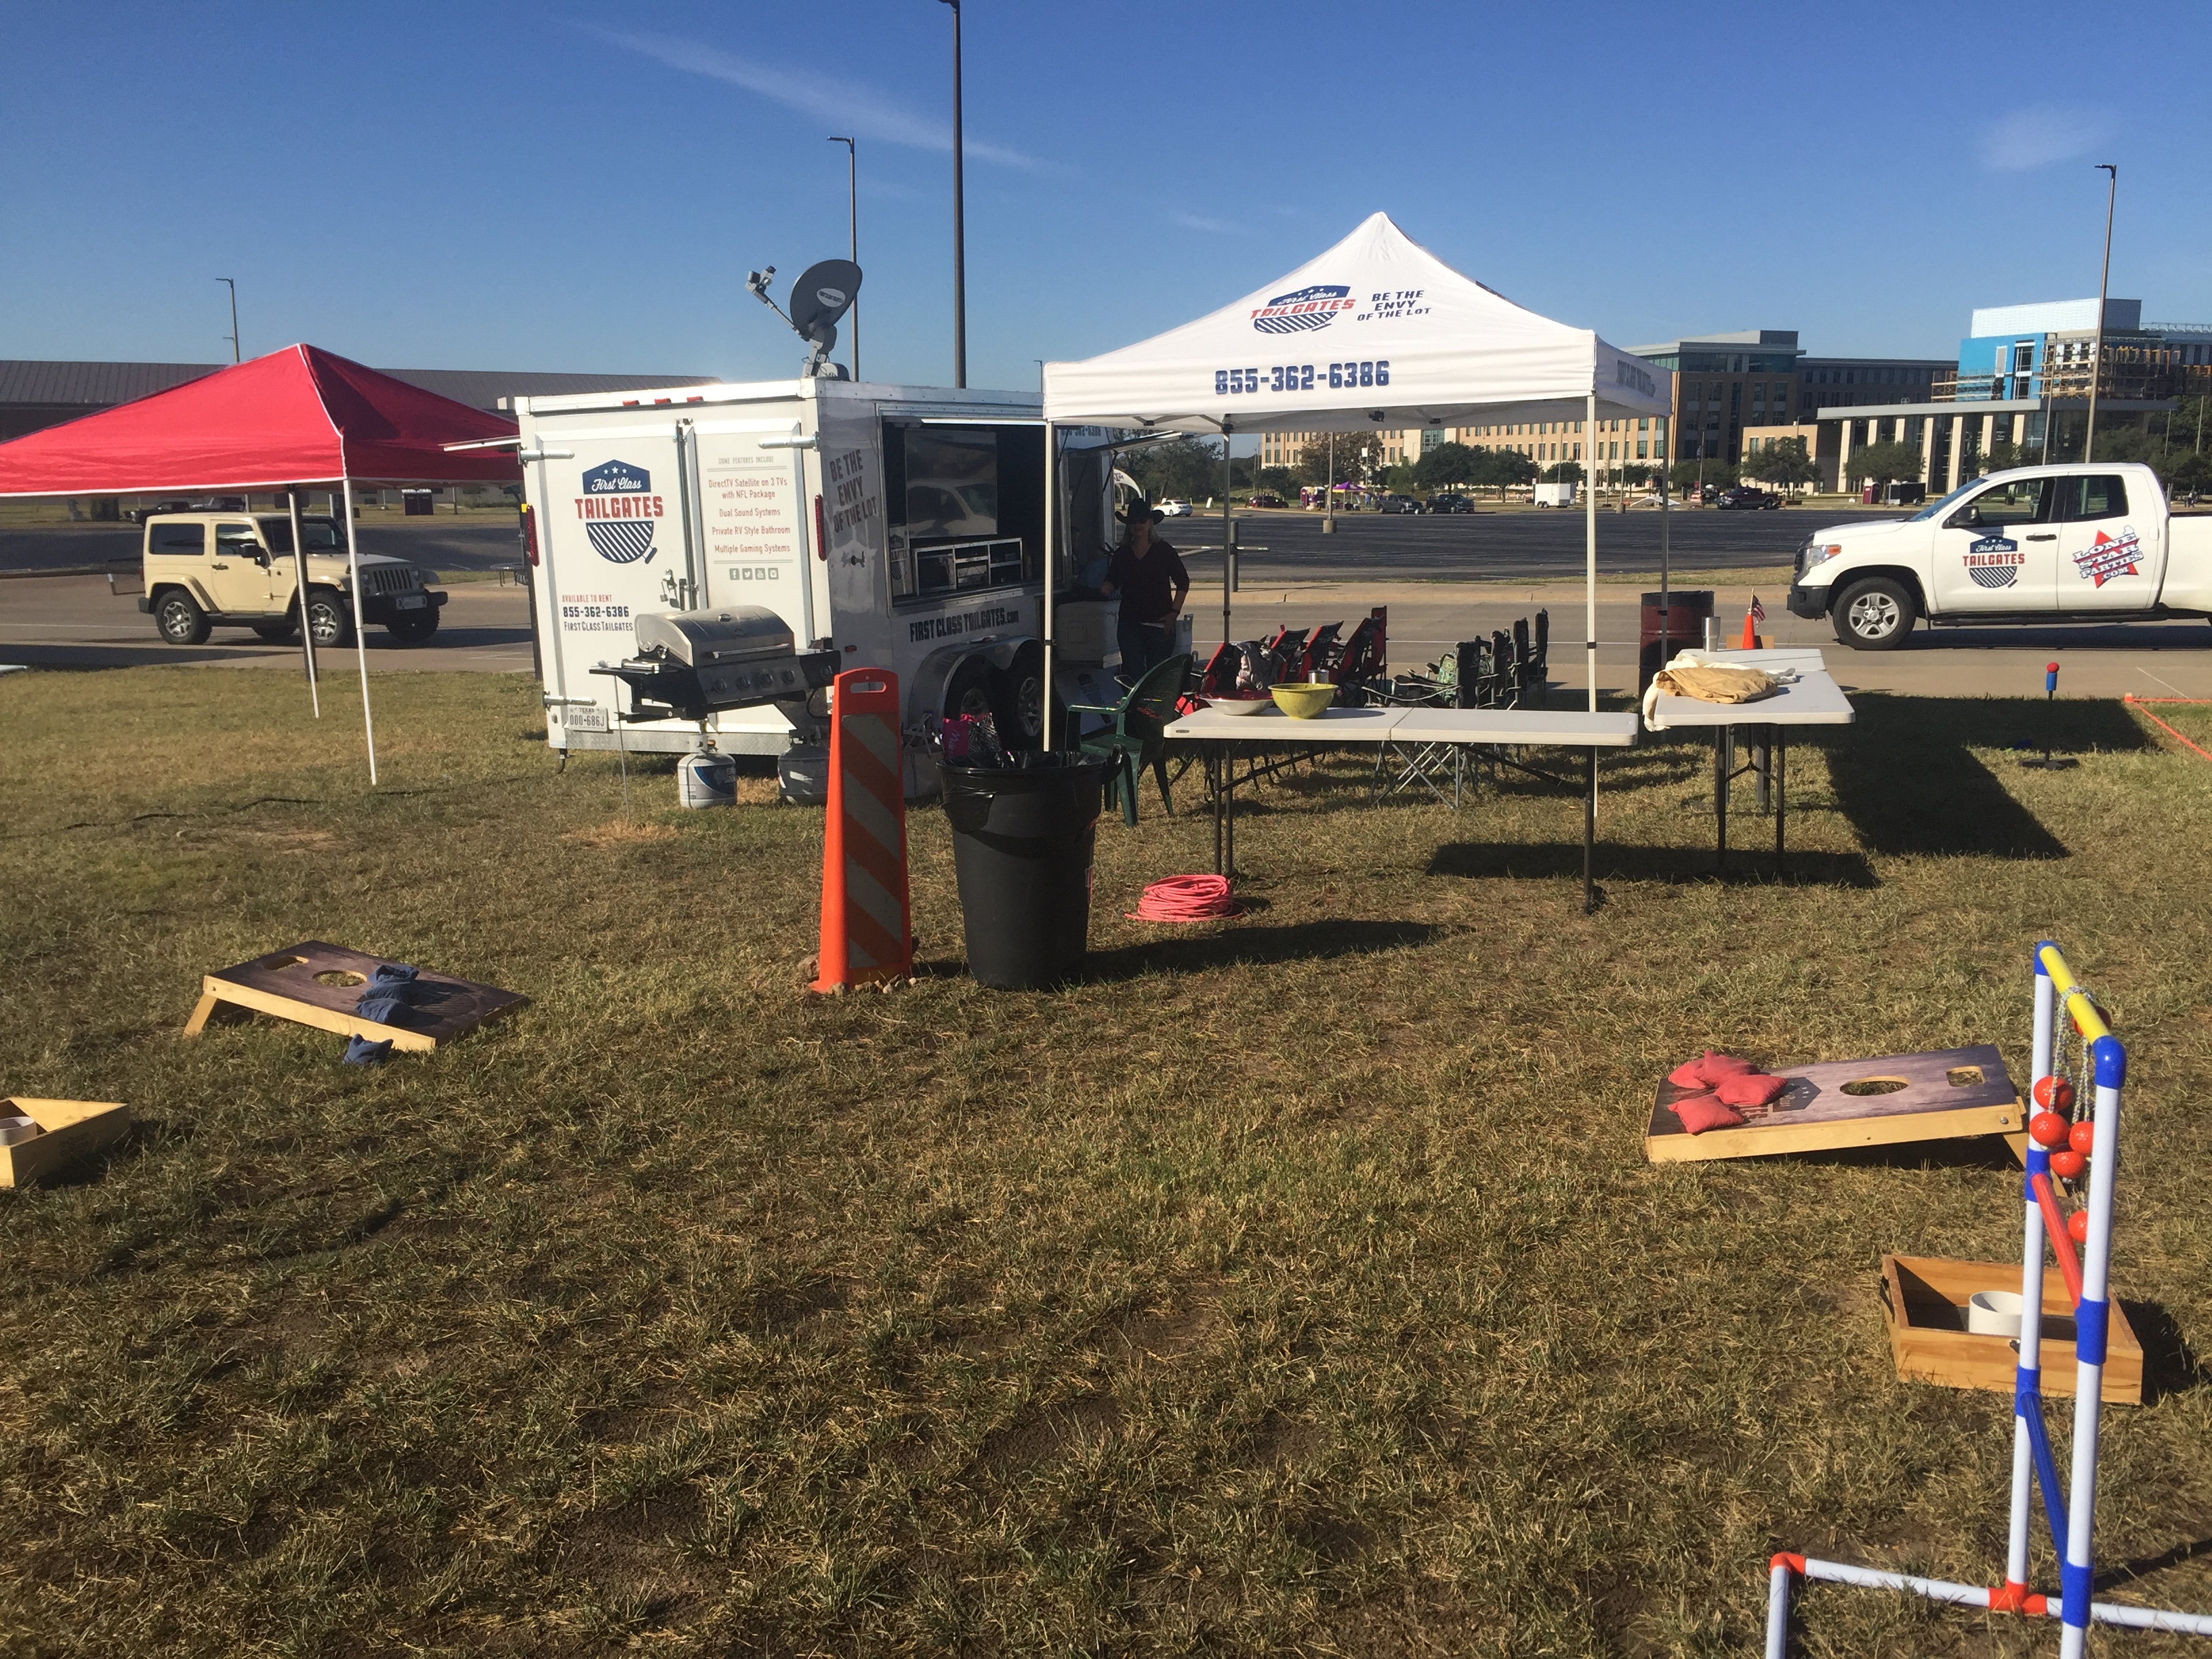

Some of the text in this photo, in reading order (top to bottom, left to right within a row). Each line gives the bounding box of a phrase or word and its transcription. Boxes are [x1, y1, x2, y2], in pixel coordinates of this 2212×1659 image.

[1372, 289, 1425, 302] BE THE
[1250, 299, 1356, 320] TAILGATES
[1374, 300, 1416, 311] ENVY
[1357, 307, 1431, 321] OF THE LOT
[1215, 360, 1389, 395] 855-362-6386
[830, 449, 863, 483] BE THE
[591, 476, 642, 491] First Class
[708, 478, 733, 488] DirectTV
[735, 478, 760, 487] Satellite
[771, 477, 775, 486] 3
[776, 477, 787, 486] TVs
[722, 489, 775, 500] with NFL Package
[837, 475, 863, 507] ENVY
[574, 495, 663, 520] TAILGATES
[719, 508, 781, 518] Dual Sound Systems
[833, 496, 877, 533] OF THE LOT
[712, 525, 790, 537] Private RV Style Bathroom
[714, 544, 790, 555] Multiple Gaming Systems
[1975, 544, 1994, 552] First
[2072, 532, 2137, 560] LONE
[1963, 553, 2025, 567] TAILGATES
[2078, 544, 2139, 570] STAR
[2079, 550, 2144, 579] PARTIES
[562, 594, 612, 602] AVAILABLE TO RENT
[562, 606, 630, 617] 855-362-6386
[909, 619, 935, 643] FIRST
[936, 614, 963, 638] CLASS
